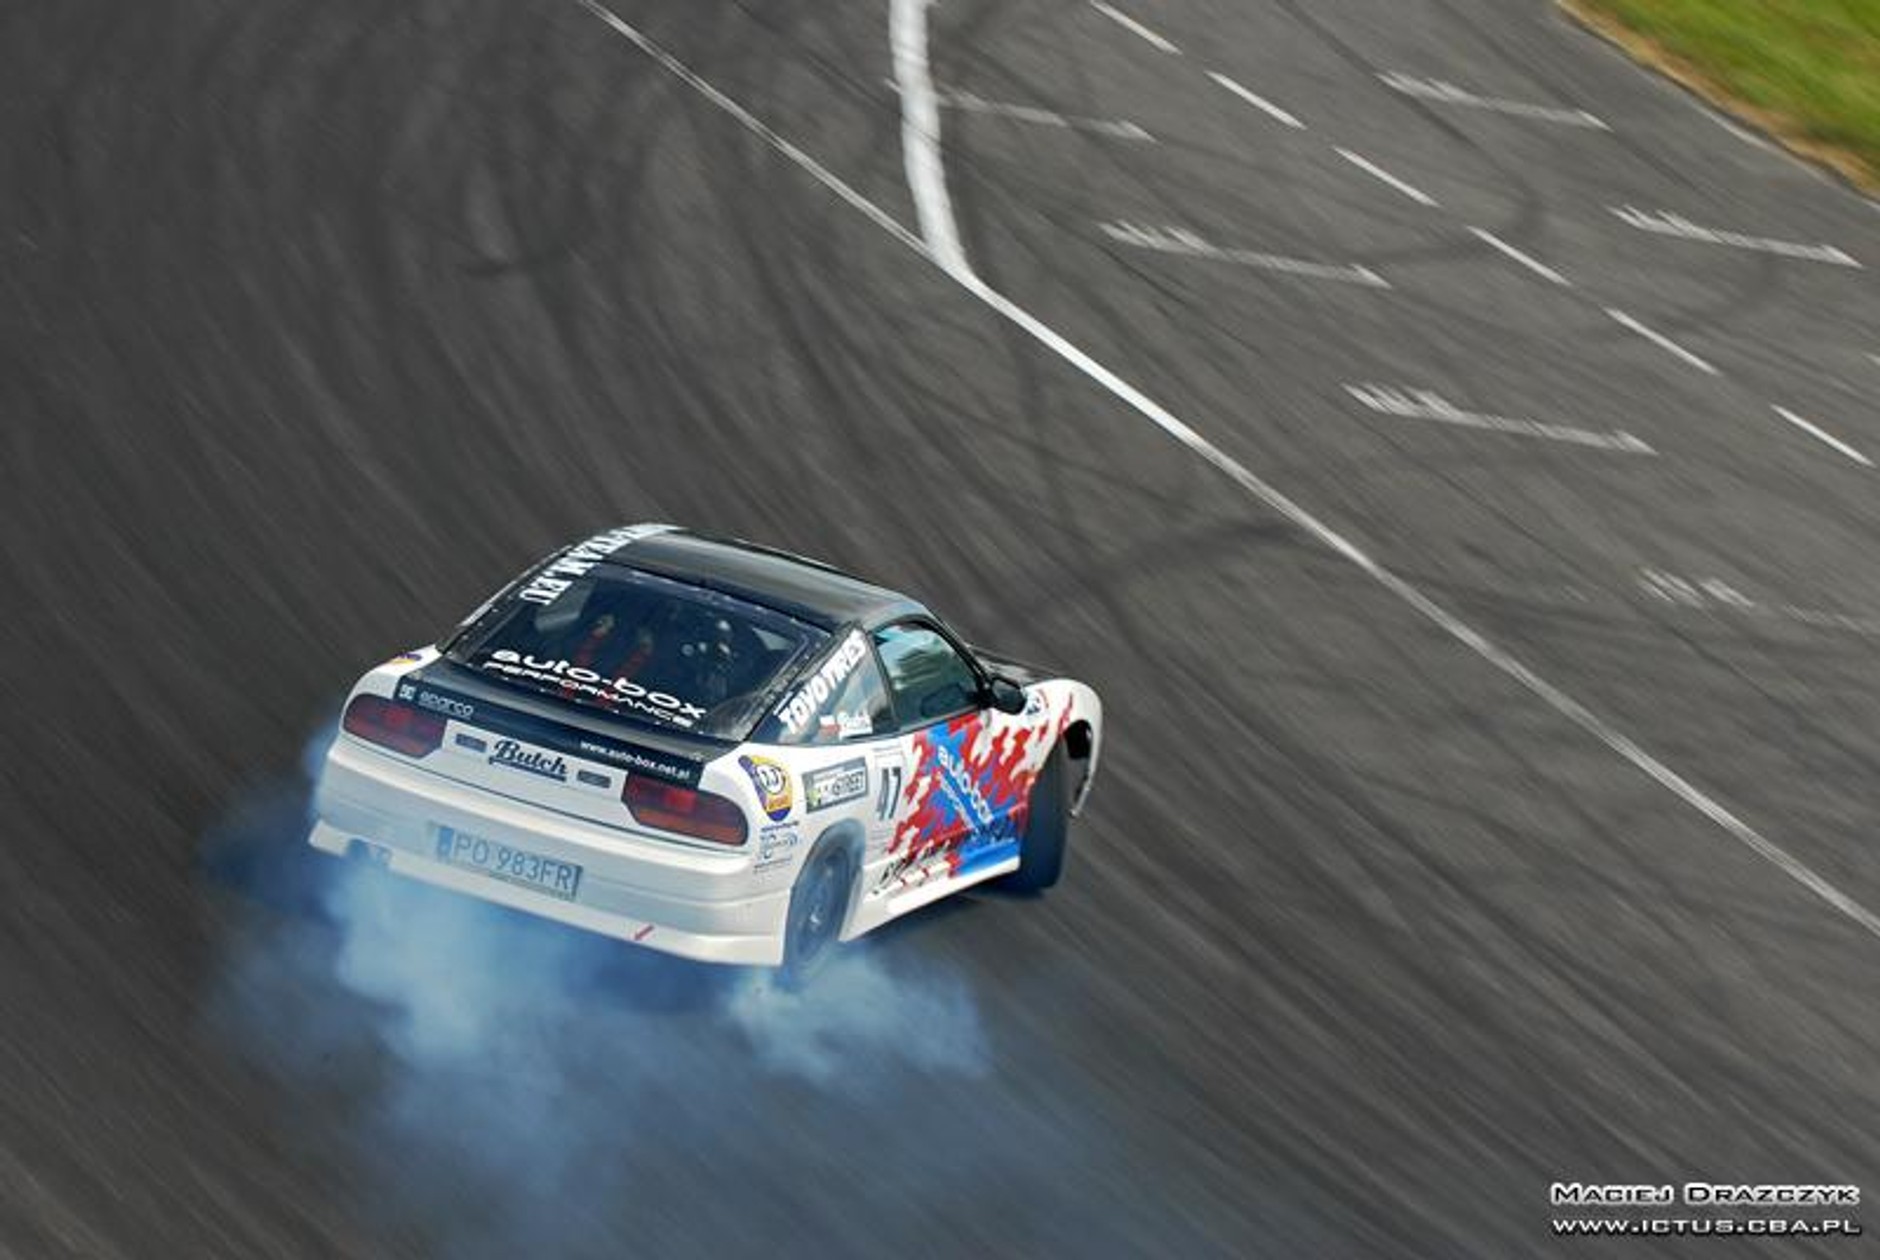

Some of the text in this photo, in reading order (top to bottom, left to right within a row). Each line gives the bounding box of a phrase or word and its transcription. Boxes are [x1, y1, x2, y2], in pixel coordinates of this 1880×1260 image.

[481, 661, 694, 729] PERFORMANCE
[490, 648, 708, 721] auto-box
[491, 738, 570, 777] Butch
[453, 832, 574, 891] PO 983FR
